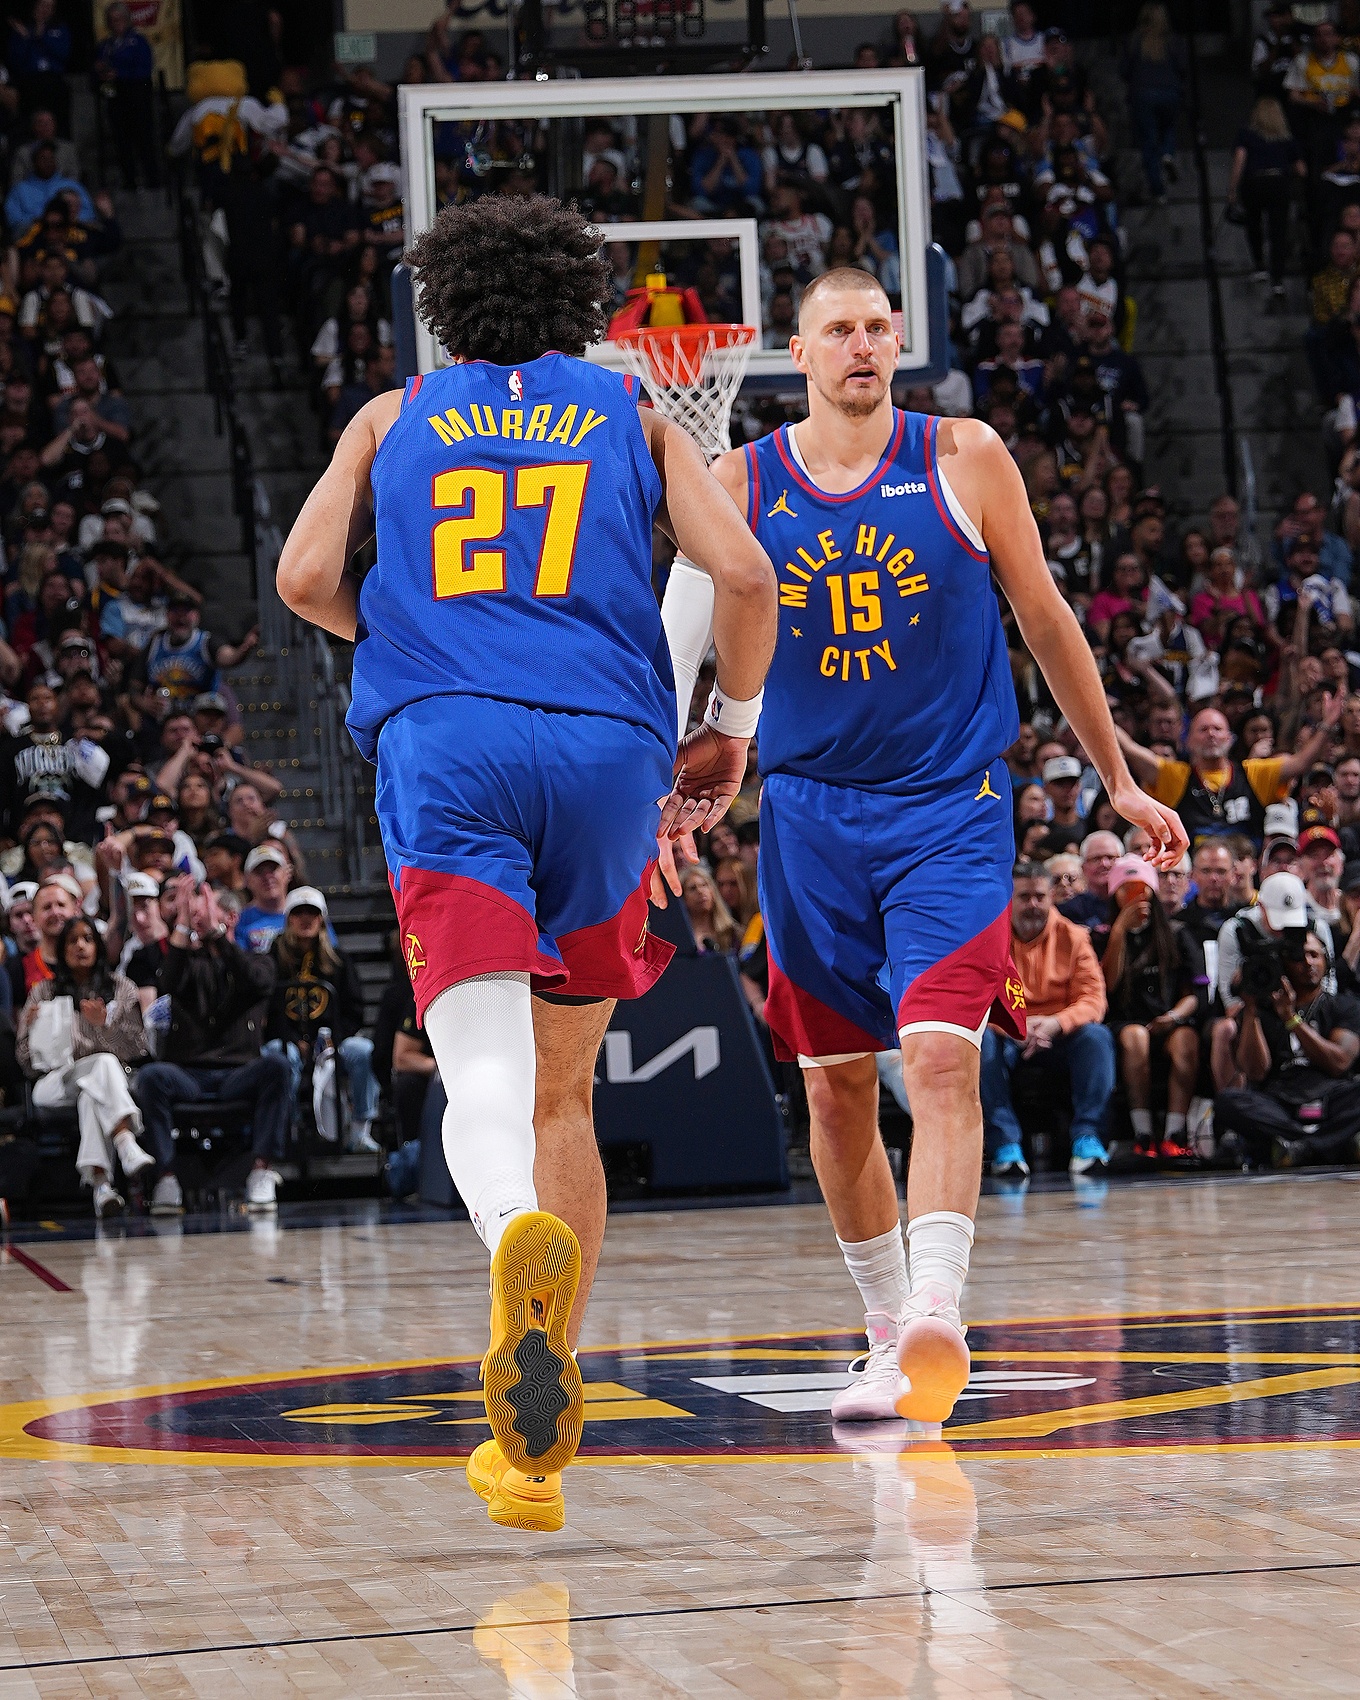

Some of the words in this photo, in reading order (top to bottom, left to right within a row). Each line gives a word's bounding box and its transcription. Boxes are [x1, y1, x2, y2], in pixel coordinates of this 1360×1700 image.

[427, 403, 608, 448] MURRAY
[880, 481, 927, 499] ibotta
[431, 460, 592, 602] 27
[779, 528, 843, 609] MILE
[855, 523, 930, 599] HIGH
[825, 570, 883, 636] 15
[819, 638, 898, 682] CITY
